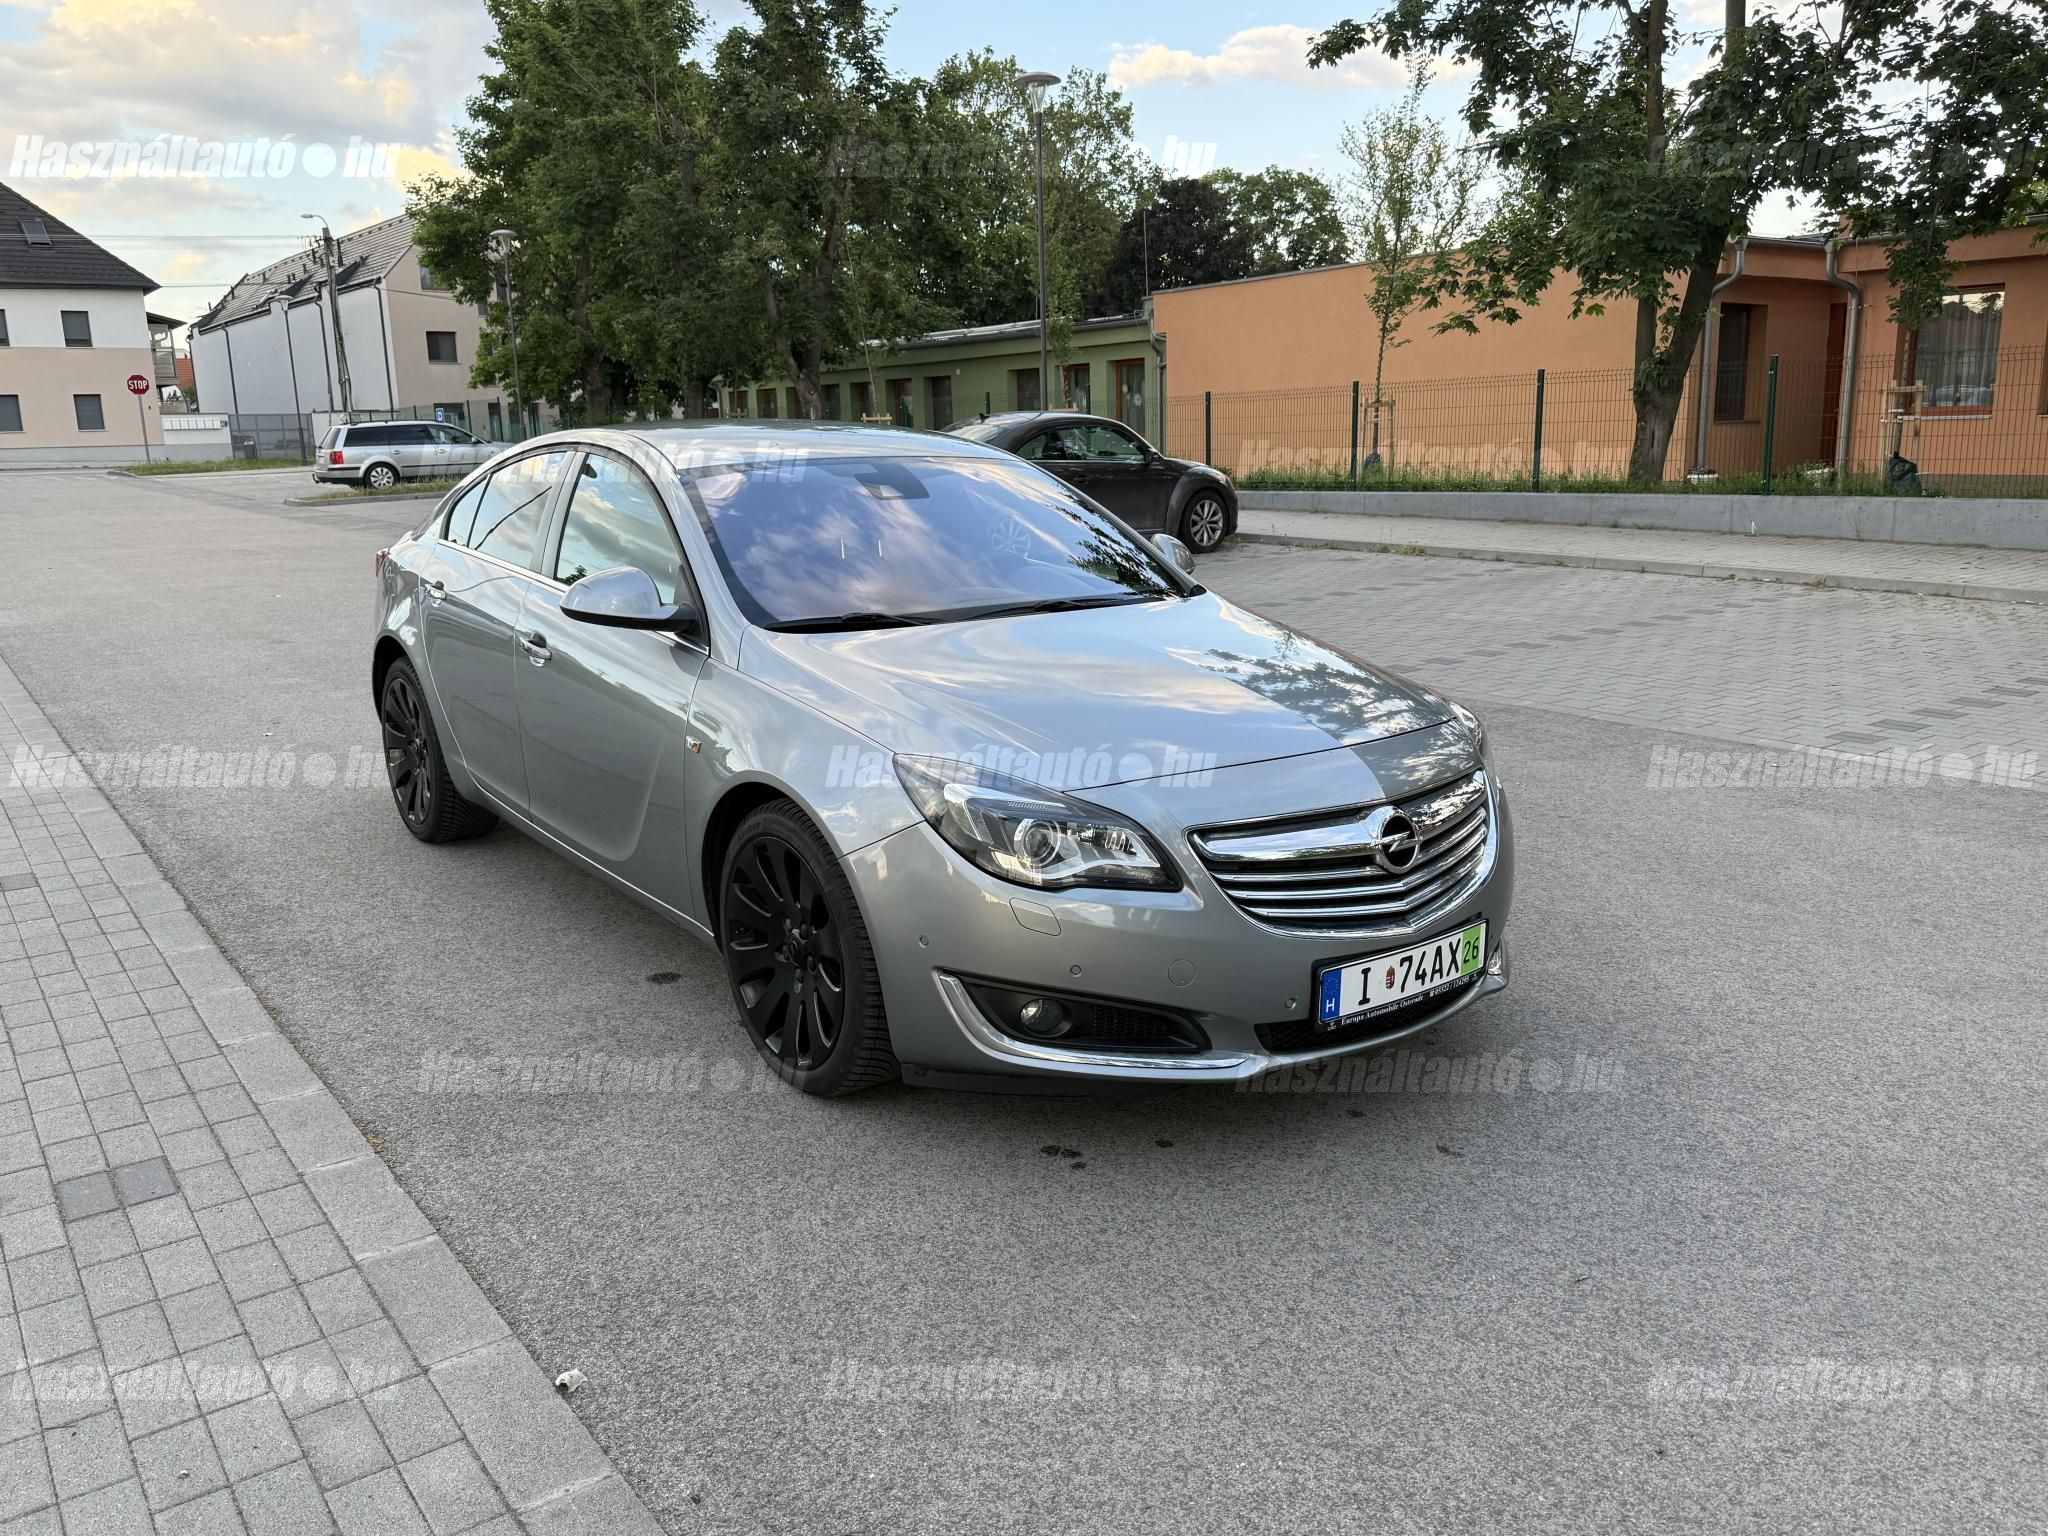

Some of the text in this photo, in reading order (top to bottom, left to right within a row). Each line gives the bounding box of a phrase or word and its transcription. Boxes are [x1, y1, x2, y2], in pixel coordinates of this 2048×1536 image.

[128, 380, 148, 390] STOP
[1358, 936, 1480, 1006] I 74AX 26
[1325, 997, 1335, 1013] H
